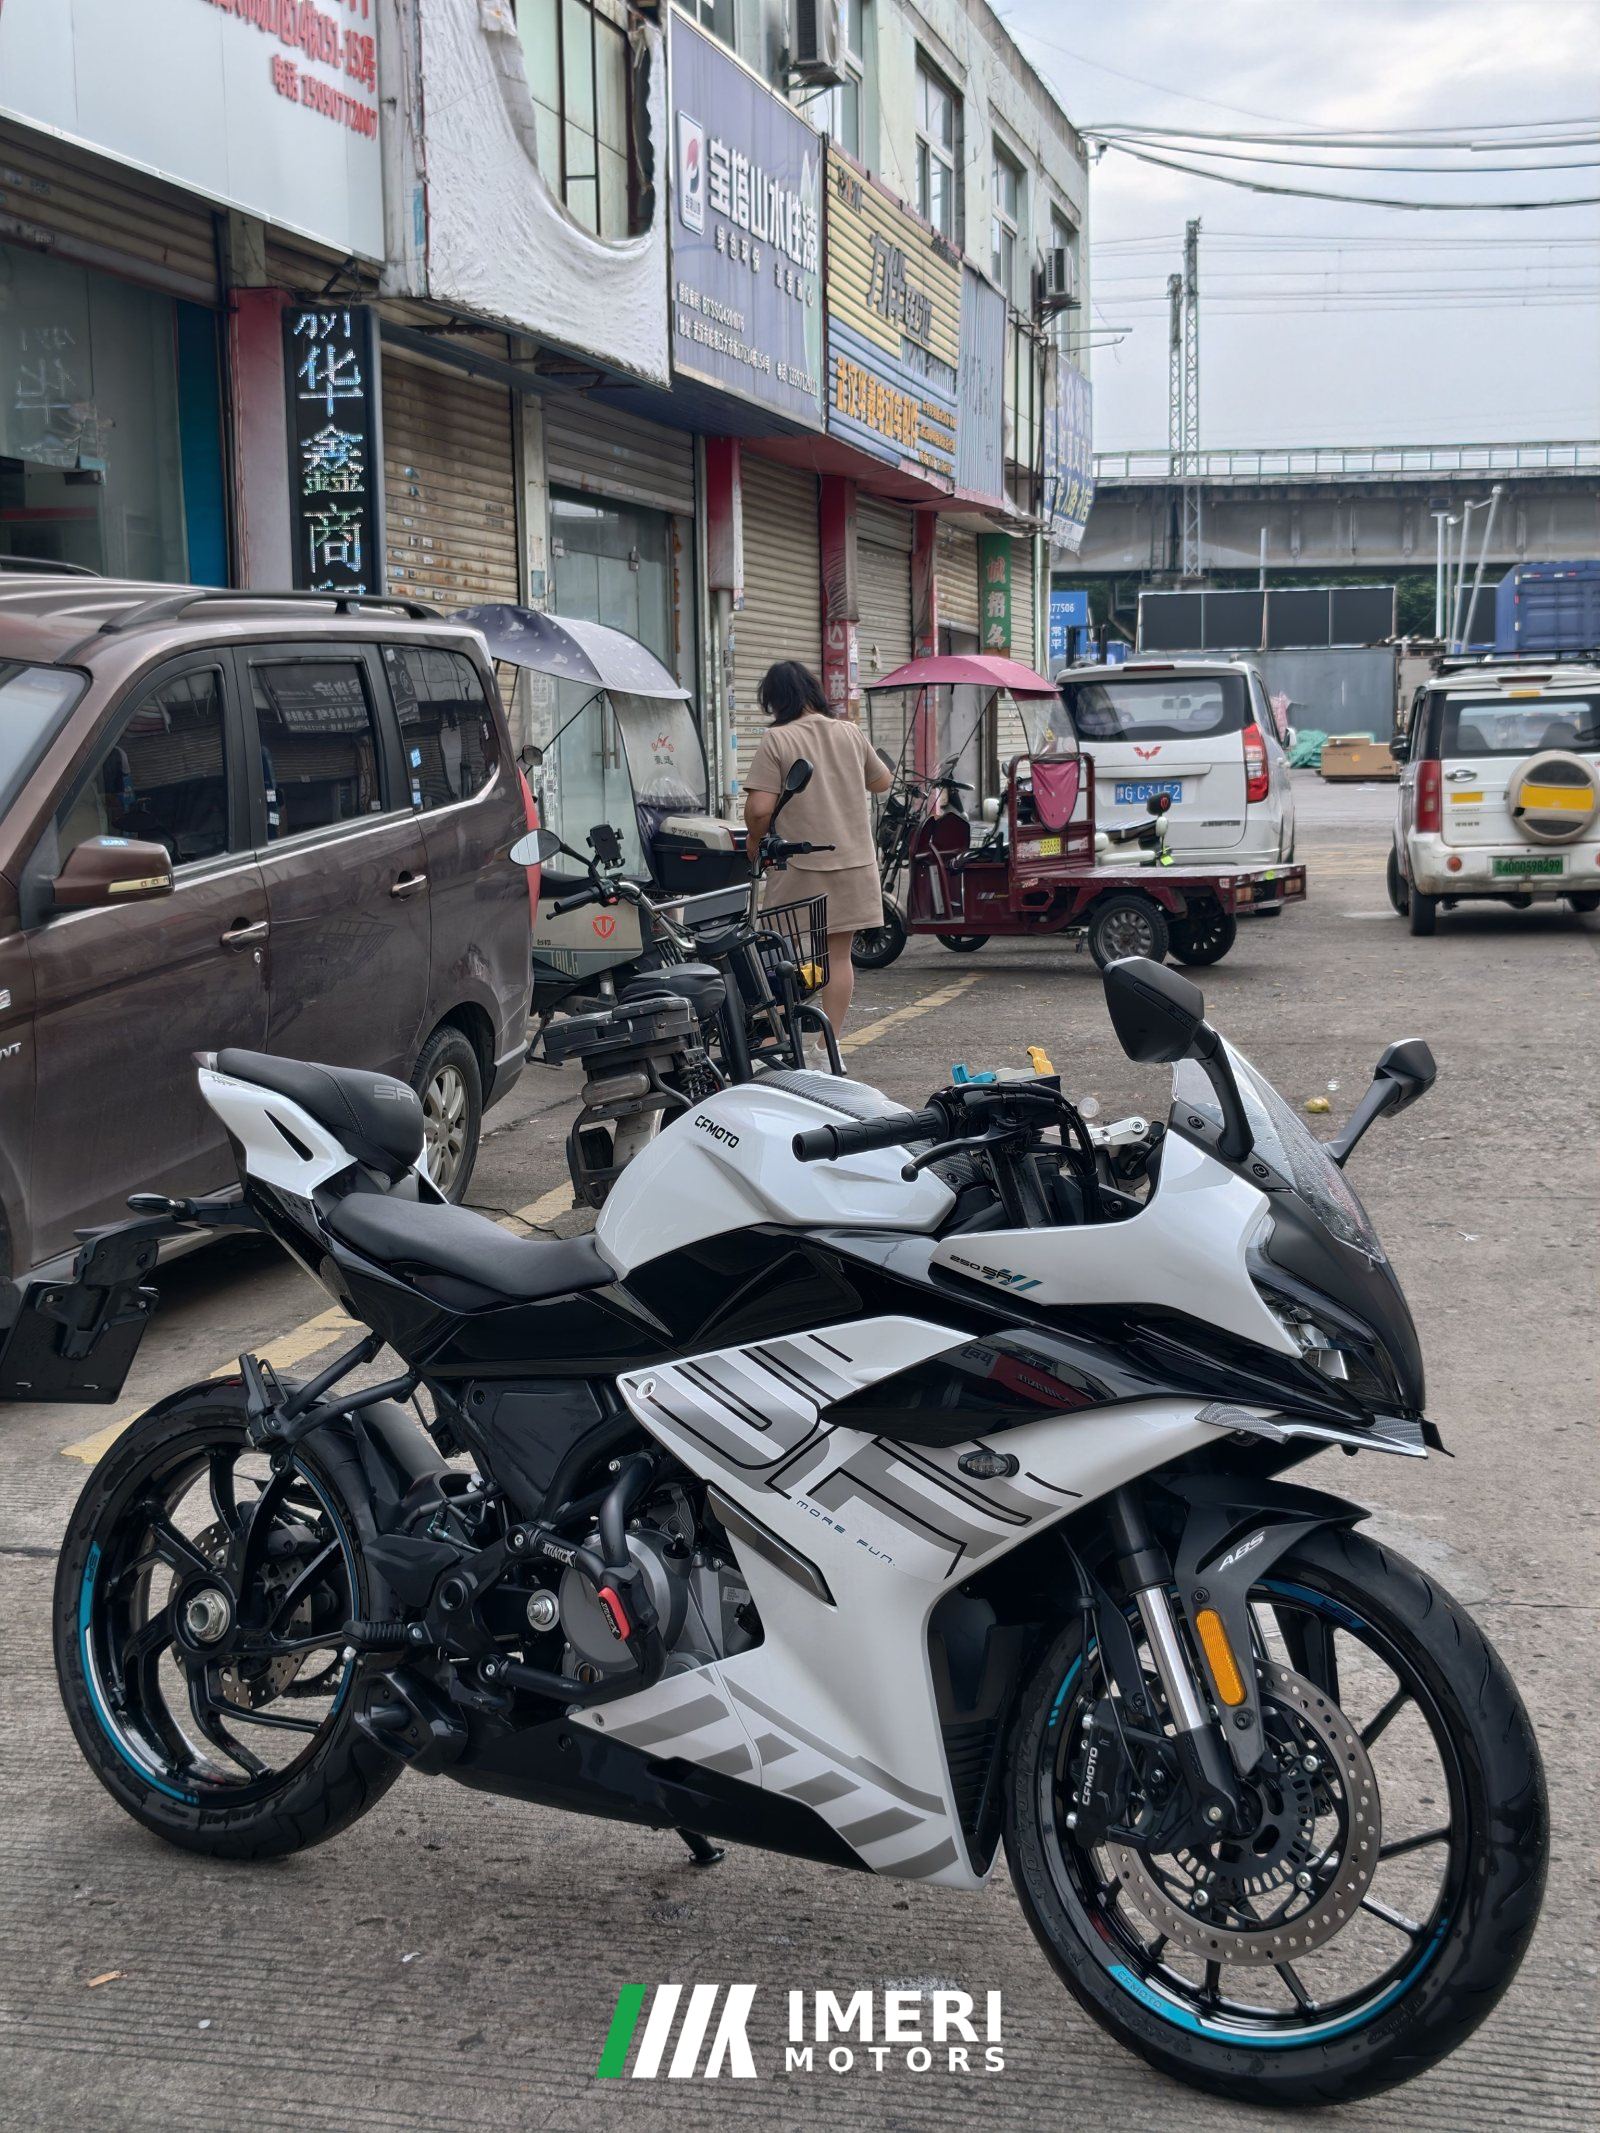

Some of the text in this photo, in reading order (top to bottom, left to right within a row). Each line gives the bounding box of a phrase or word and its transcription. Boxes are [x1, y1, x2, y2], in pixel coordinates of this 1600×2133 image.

[709, 137, 817, 275] 宝塔山水性漆
[374, 1084, 415, 1105] SR
[694, 1114, 740, 1149] CFMOTO
[796, 1500, 846, 1535] MORE
[1218, 1531, 1265, 1572] ABS
[1081, 1746, 1098, 1807] CFMOTO
